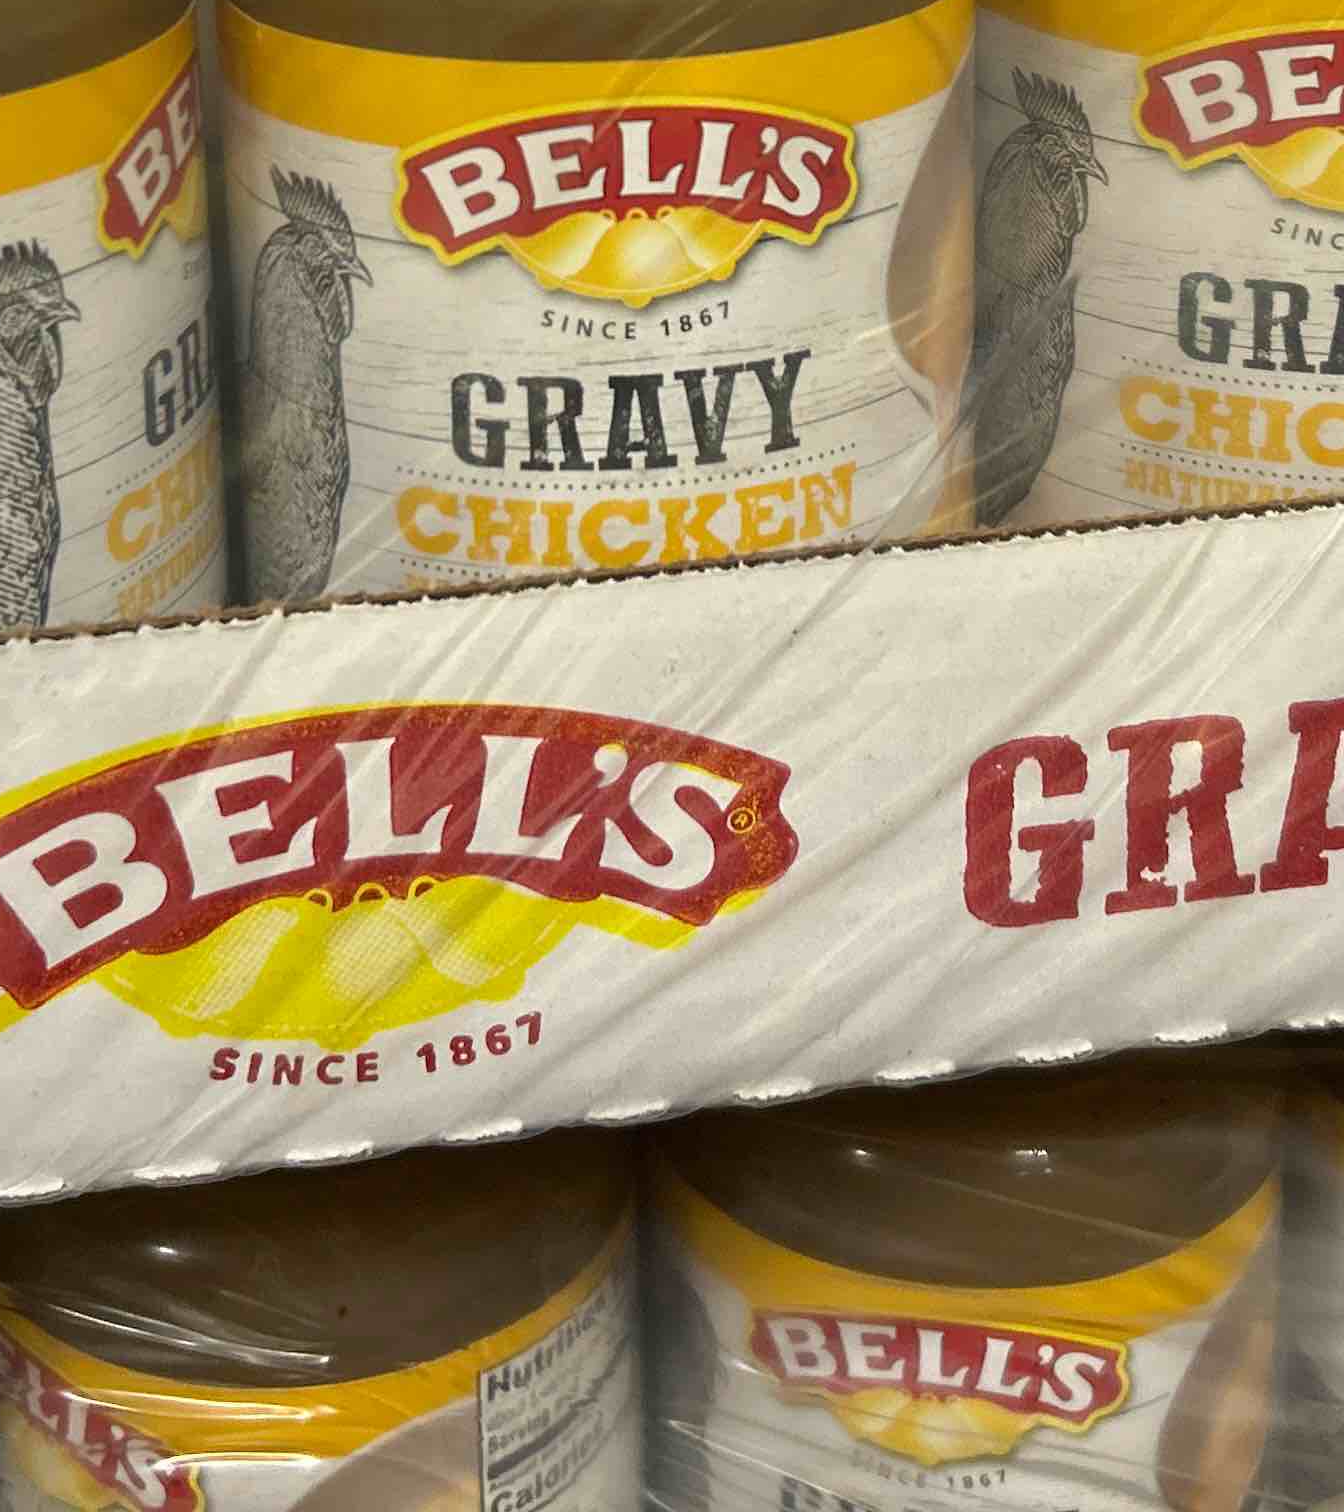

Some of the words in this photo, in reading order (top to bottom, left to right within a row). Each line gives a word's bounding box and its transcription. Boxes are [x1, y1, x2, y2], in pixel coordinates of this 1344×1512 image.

[421, 118, 834, 238] BELL'S
[541, 308, 638, 342] SINCE
[660, 301, 732, 337] 1867
[450, 349, 811, 471] GRAVY
[394, 462, 858, 568] CHICKEN
[209, 1044, 381, 1086] SINCE
[415, 1010, 544, 1076] 1867
[762, 1316, 1107, 1415] BELL'S
[946, 1469, 1007, 1490] 1867
